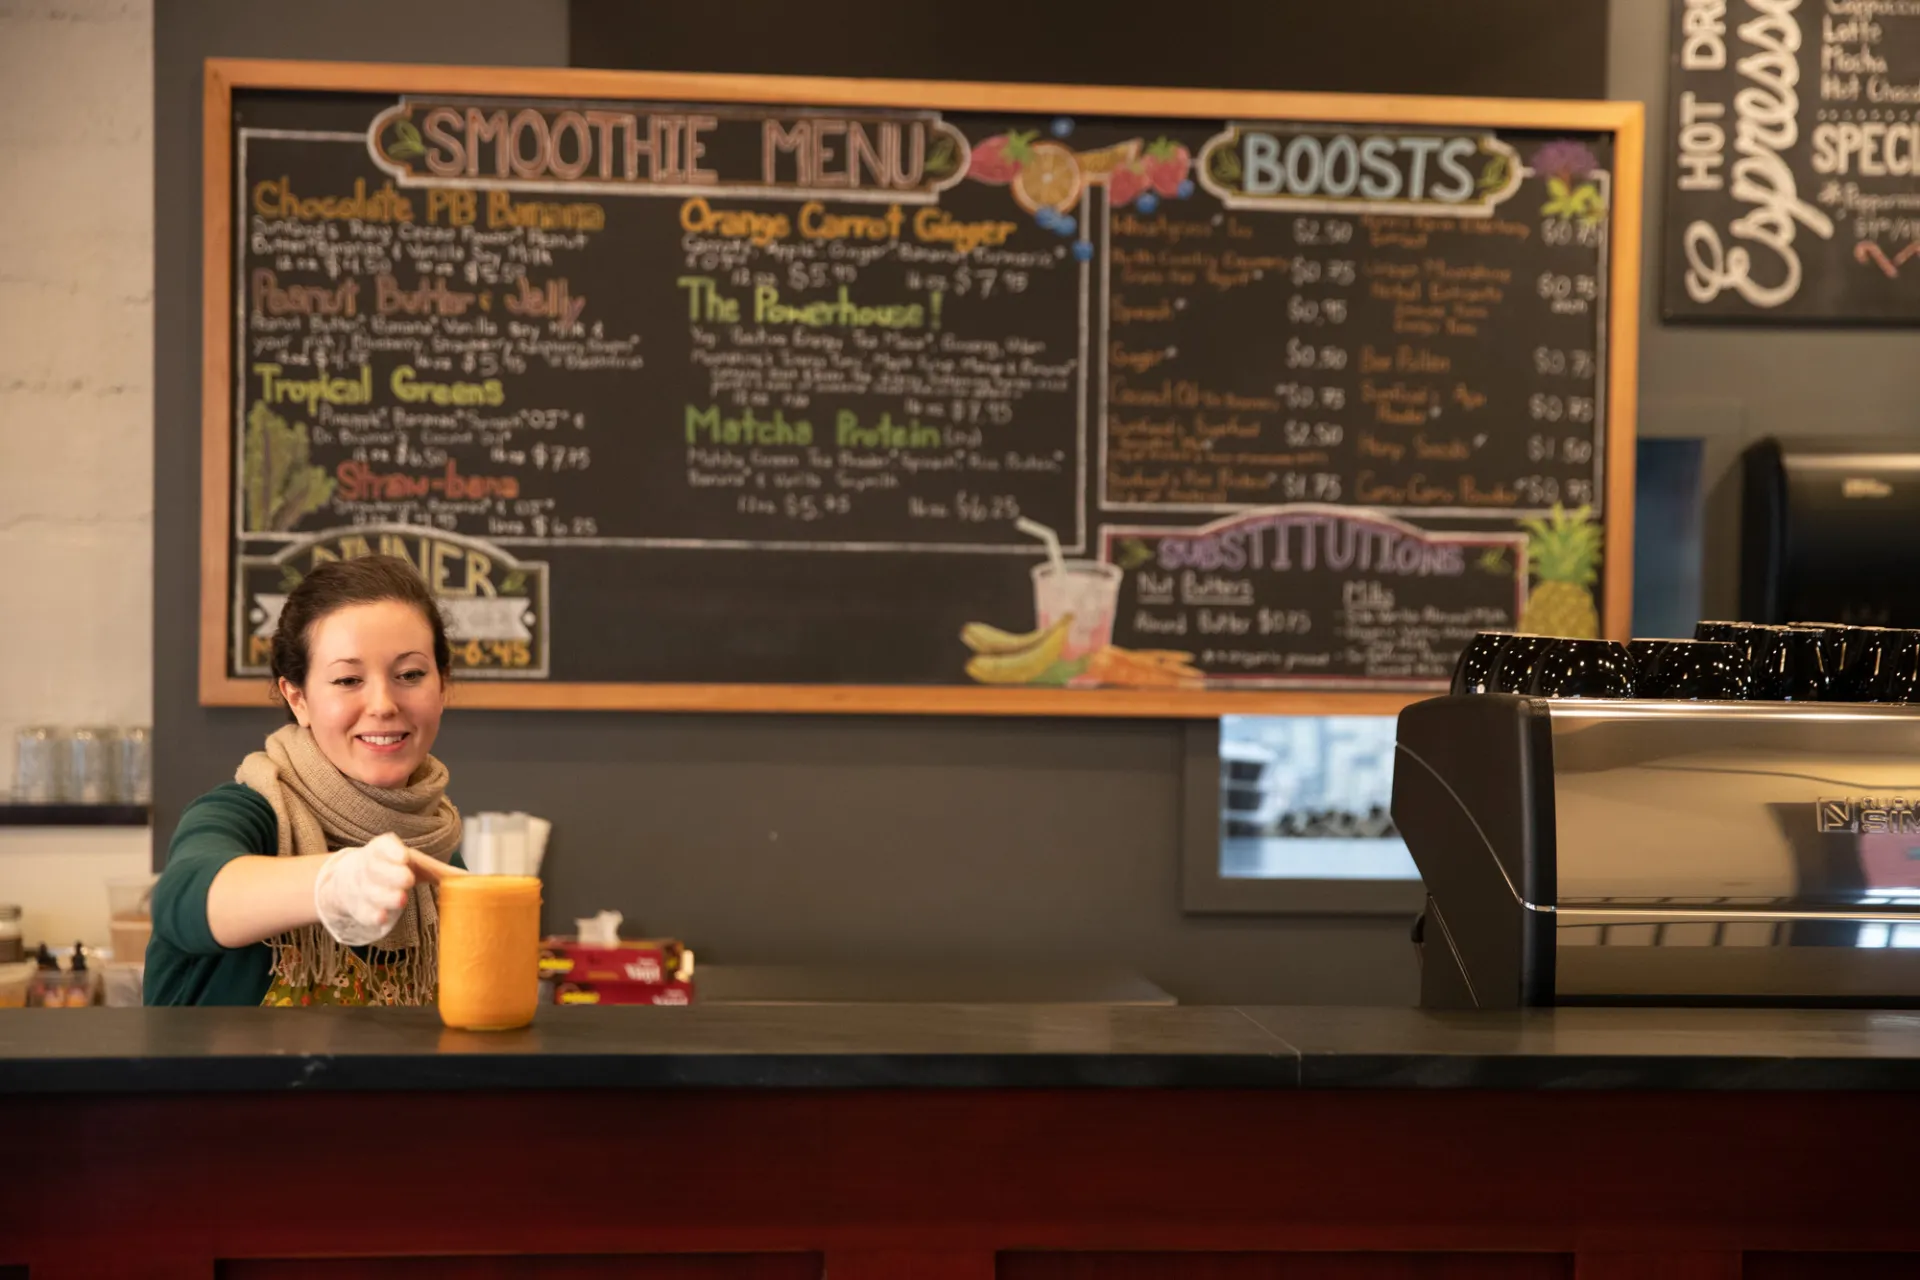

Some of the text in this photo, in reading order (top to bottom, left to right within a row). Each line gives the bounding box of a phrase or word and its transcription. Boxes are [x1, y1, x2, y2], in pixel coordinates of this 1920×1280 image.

[1822, 14, 1882, 44] Latte
[1821, 43, 1888, 73] Mocha
[1678, 0, 1727, 190] HOT DR
[1820, 73, 1861, 101] Hot
[423, 107, 926, 188] SMOOTHIE MENU
[1243, 132, 1477, 203] BOOSTS
[1684, 0, 1834, 308] Espress
[254, 176, 605, 230] Chocolate PB Banana
[680, 196, 791, 246] Orange
[798, 201, 906, 240] Carrot
[914, 206, 1018, 253] Ginger
[251, 268, 361, 318] Peanut
[375, 272, 476, 317] Butter
[503, 275, 586, 328] Jelly
[677, 275, 740, 323] The
[253, 363, 505, 418] Tropical Greens
[685, 403, 813, 446] Matcha
[836, 407, 941, 449] Protein
[336, 457, 520, 502] Straw-bana
